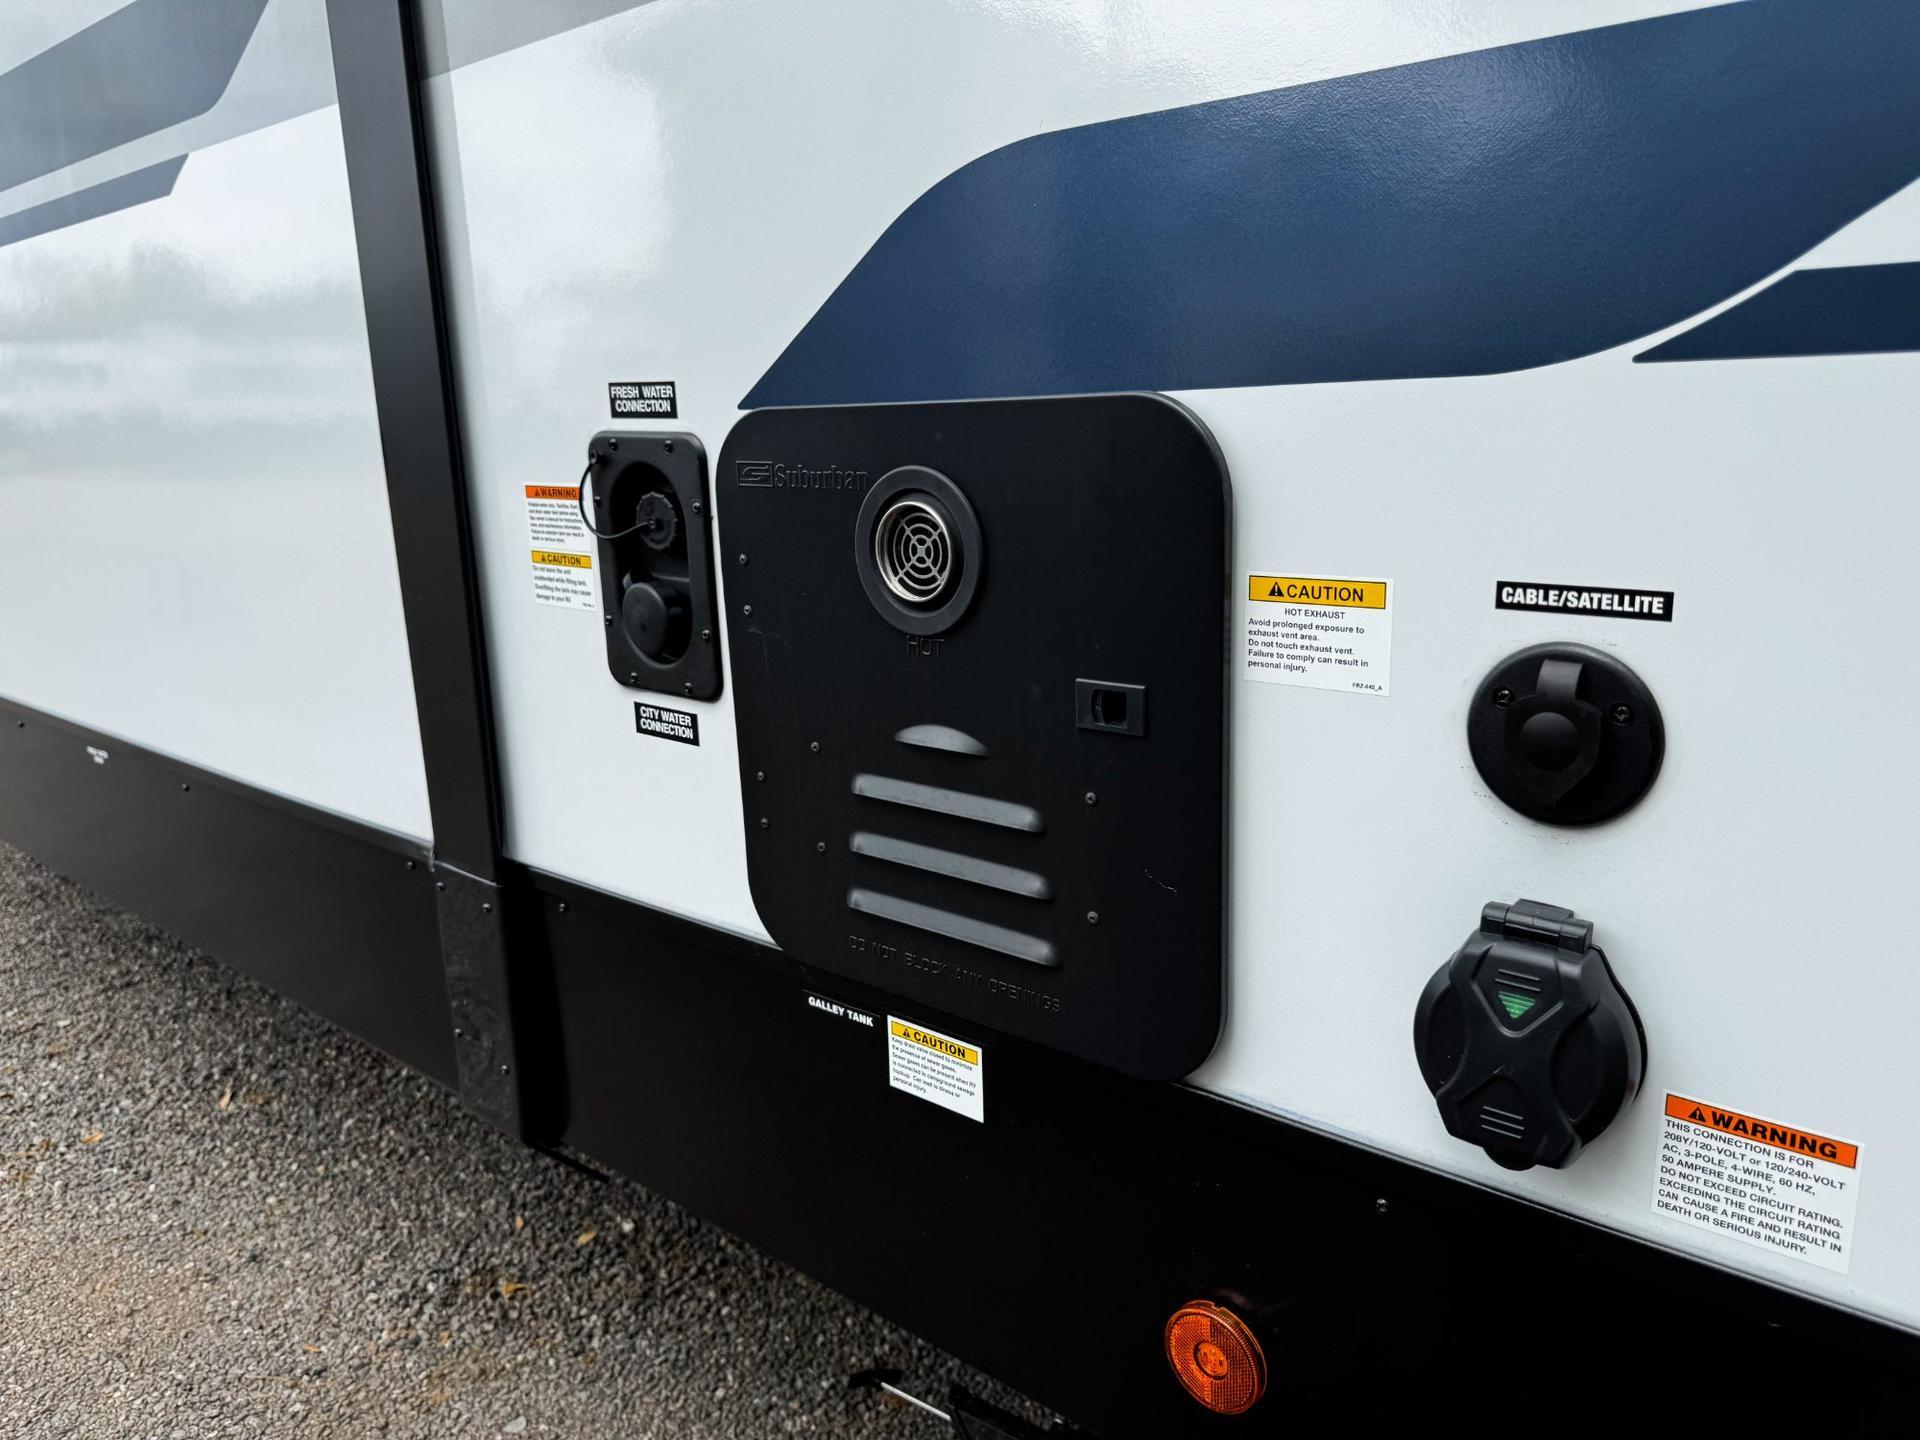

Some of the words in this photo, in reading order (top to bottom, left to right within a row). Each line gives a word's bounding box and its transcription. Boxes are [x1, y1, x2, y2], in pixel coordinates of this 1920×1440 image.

[610, 386, 640, 398] FRESH
[642, 386, 674, 398] WATER
[615, 400, 670, 412] CONNECTION
[775, 464, 868, 490] Suburban
[540, 488, 577, 498] WARNING
[548, 554, 581, 565] CAUTION
[1287, 584, 1363, 602] CAUTION
[1502, 587, 1664, 614] CABLE/SATELLITE
[1248, 618, 1270, 626] Avoid
[1272, 620, 1313, 631] prolonged
[1315, 624, 1353, 634] exposure
[1304, 610, 1345, 619] EXHAUST
[906, 634, 944, 656] HOT
[1248, 628, 1278, 638] exhaust
[1248, 649, 1274, 658] Failure
[1286, 653, 1315, 663] comply
[1335, 658, 1358, 666] result
[1276, 641, 1298, 650] touch
[1300, 643, 1332, 653] exhaust
[1248, 659, 1281, 670] personal
[1283, 663, 1308, 673] injury.
[640, 706, 659, 720] CITY
[660, 710, 692, 726] WATER
[640, 718, 694, 739] CONNECTION
[849, 936, 866, 952] DO
[872, 942, 898, 961] NOT
[989, 978, 1064, 1012] OPENINGS
[808, 996, 844, 1016] GALLEY
[846, 1009, 874, 1027] TANK
[914, 1031, 966, 1058] CAUTION
[1666, 1119, 1690, 1133] THIS
[1693, 1128, 1771, 1156] CONNECTION
[1774, 1151, 1786, 1161] IS
[1789, 1155, 1814, 1169] FOR
[1710, 1111, 1838, 1159] WARNING
[1662, 1143, 1681, 1155] AC,
[1684, 1149, 1728, 1170] 3-POLE,
[1730, 1163, 1776, 1184] 4-WIRE,
[1779, 1177, 1792, 1188] 60
[1795, 1182, 1816, 1196] HZ,
[1664, 1131, 1746, 1162] 208Y/120-VOLT
[1749, 1157, 1760, 1166] or
[1766, 1161, 1845, 1191] 120/240-VOLT
[1662, 1154, 1674, 1164] 50
[1677, 1158, 1724, 1179] AMPERE
[1727, 1174, 1777, 1196] SUPPLY.
[1659, 1177, 1721, 1203] EXCEEDING
[1723, 1197, 1745, 1210] THE
[1748, 1204, 1794, 1225] CIRCUIT
[1798, 1220, 1840, 1240] RATING
[1660, 1166, 1676, 1177] DO
[1679, 1171, 1700, 1184] NOT
[1703, 1179, 1746, 1199] EXCEED
[1749, 1193, 1795, 1213] CIRCUIT
[1798, 1207, 1844, 1229] RATING.
[1657, 1200, 1691, 1217] DEATH
[1694, 1211, 1710, 1223] OR
[1712, 1217, 1761, 1239] SERIOUS
[1764, 1233, 1807, 1254] INJURY.
[1658, 1189, 1678, 1201] CAN
[1683, 1196, 1718, 1214] CAUSE
[1721, 1208, 1728, 1217] A
[1730, 1211, 1755, 1226] FIRE
[1758, 1220, 1780, 1234] AND
[1784, 1228, 1826, 1248] RESULT
[1830, 1242, 1842, 1253] IN
